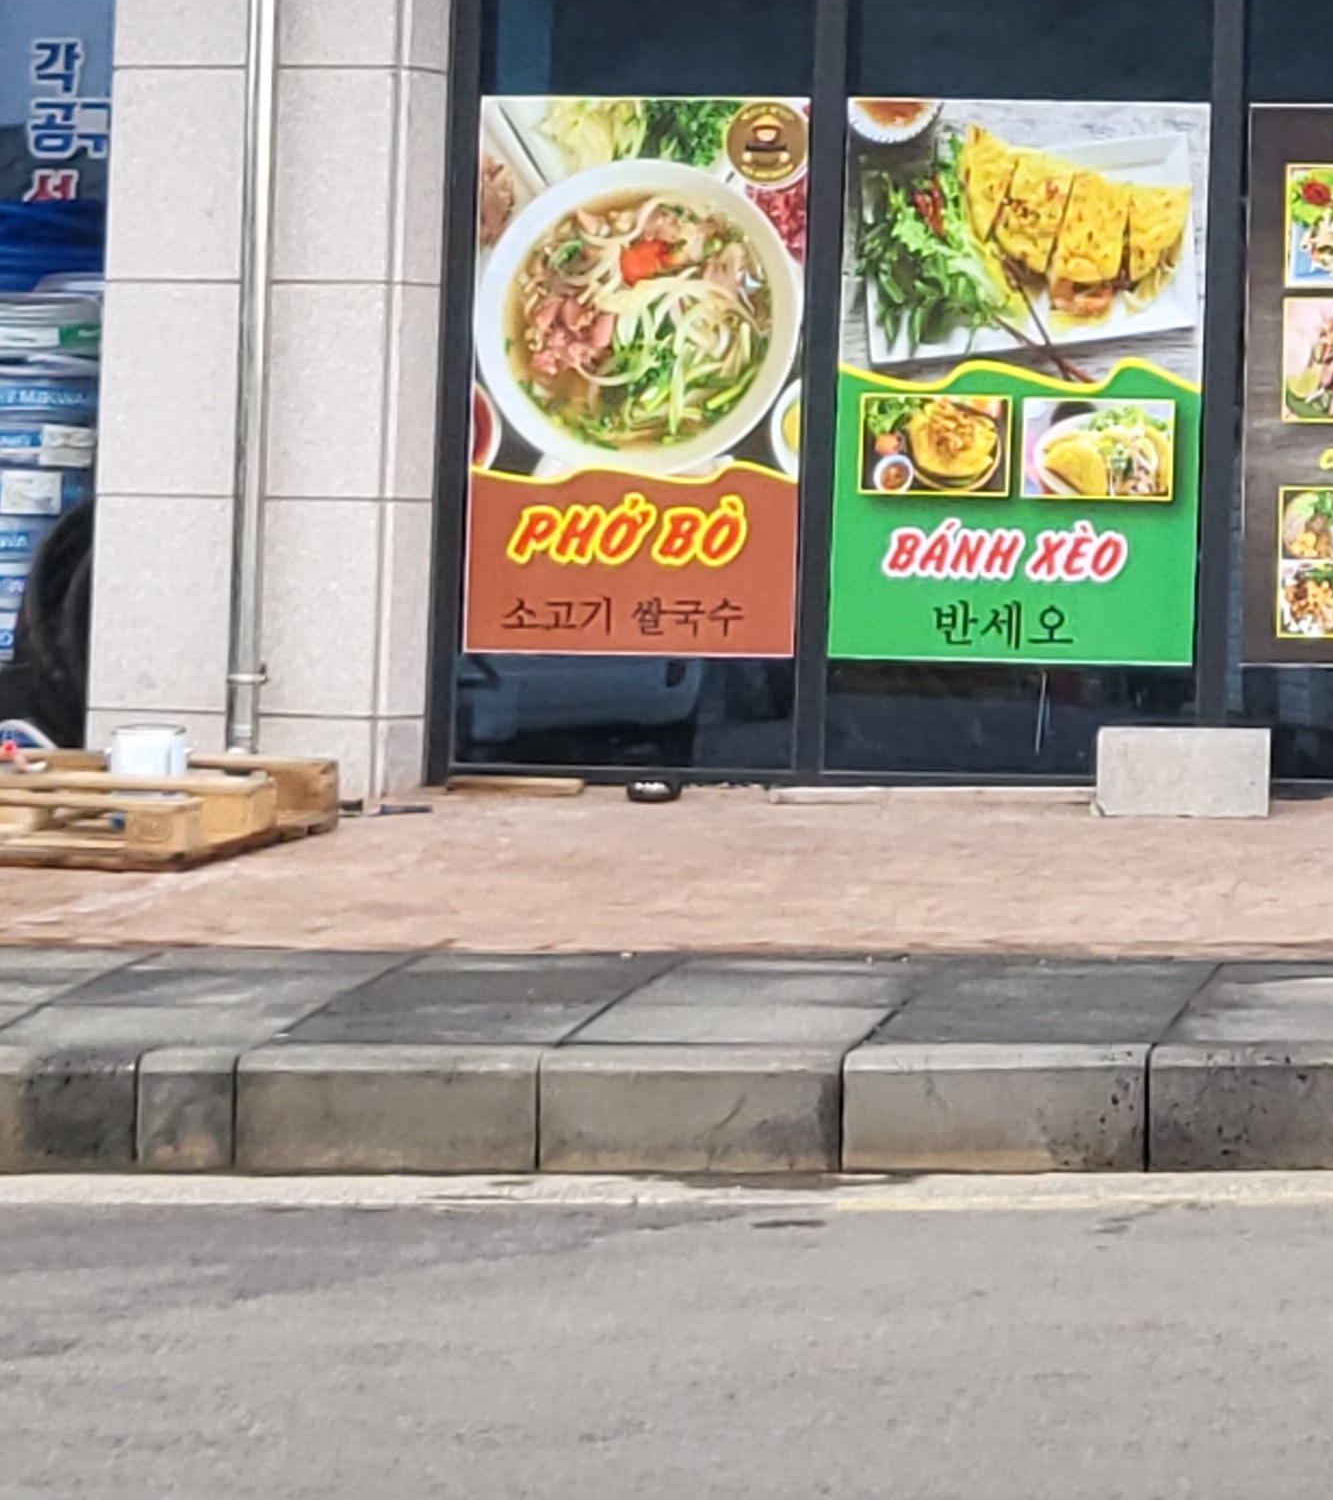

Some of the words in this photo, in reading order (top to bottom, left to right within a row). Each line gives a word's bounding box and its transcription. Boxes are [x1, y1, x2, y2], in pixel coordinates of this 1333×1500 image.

[509, 494, 656, 564] PHỞ
[653, 496, 747, 566] BÒ
[884, 519, 1024, 578] BÁNH
[1027, 522, 1127, 580] XÈO
[502, 597, 612, 637] 소고기
[631, 597, 745, 638] 쌀국수
[932, 599, 1075, 651] 반세오
